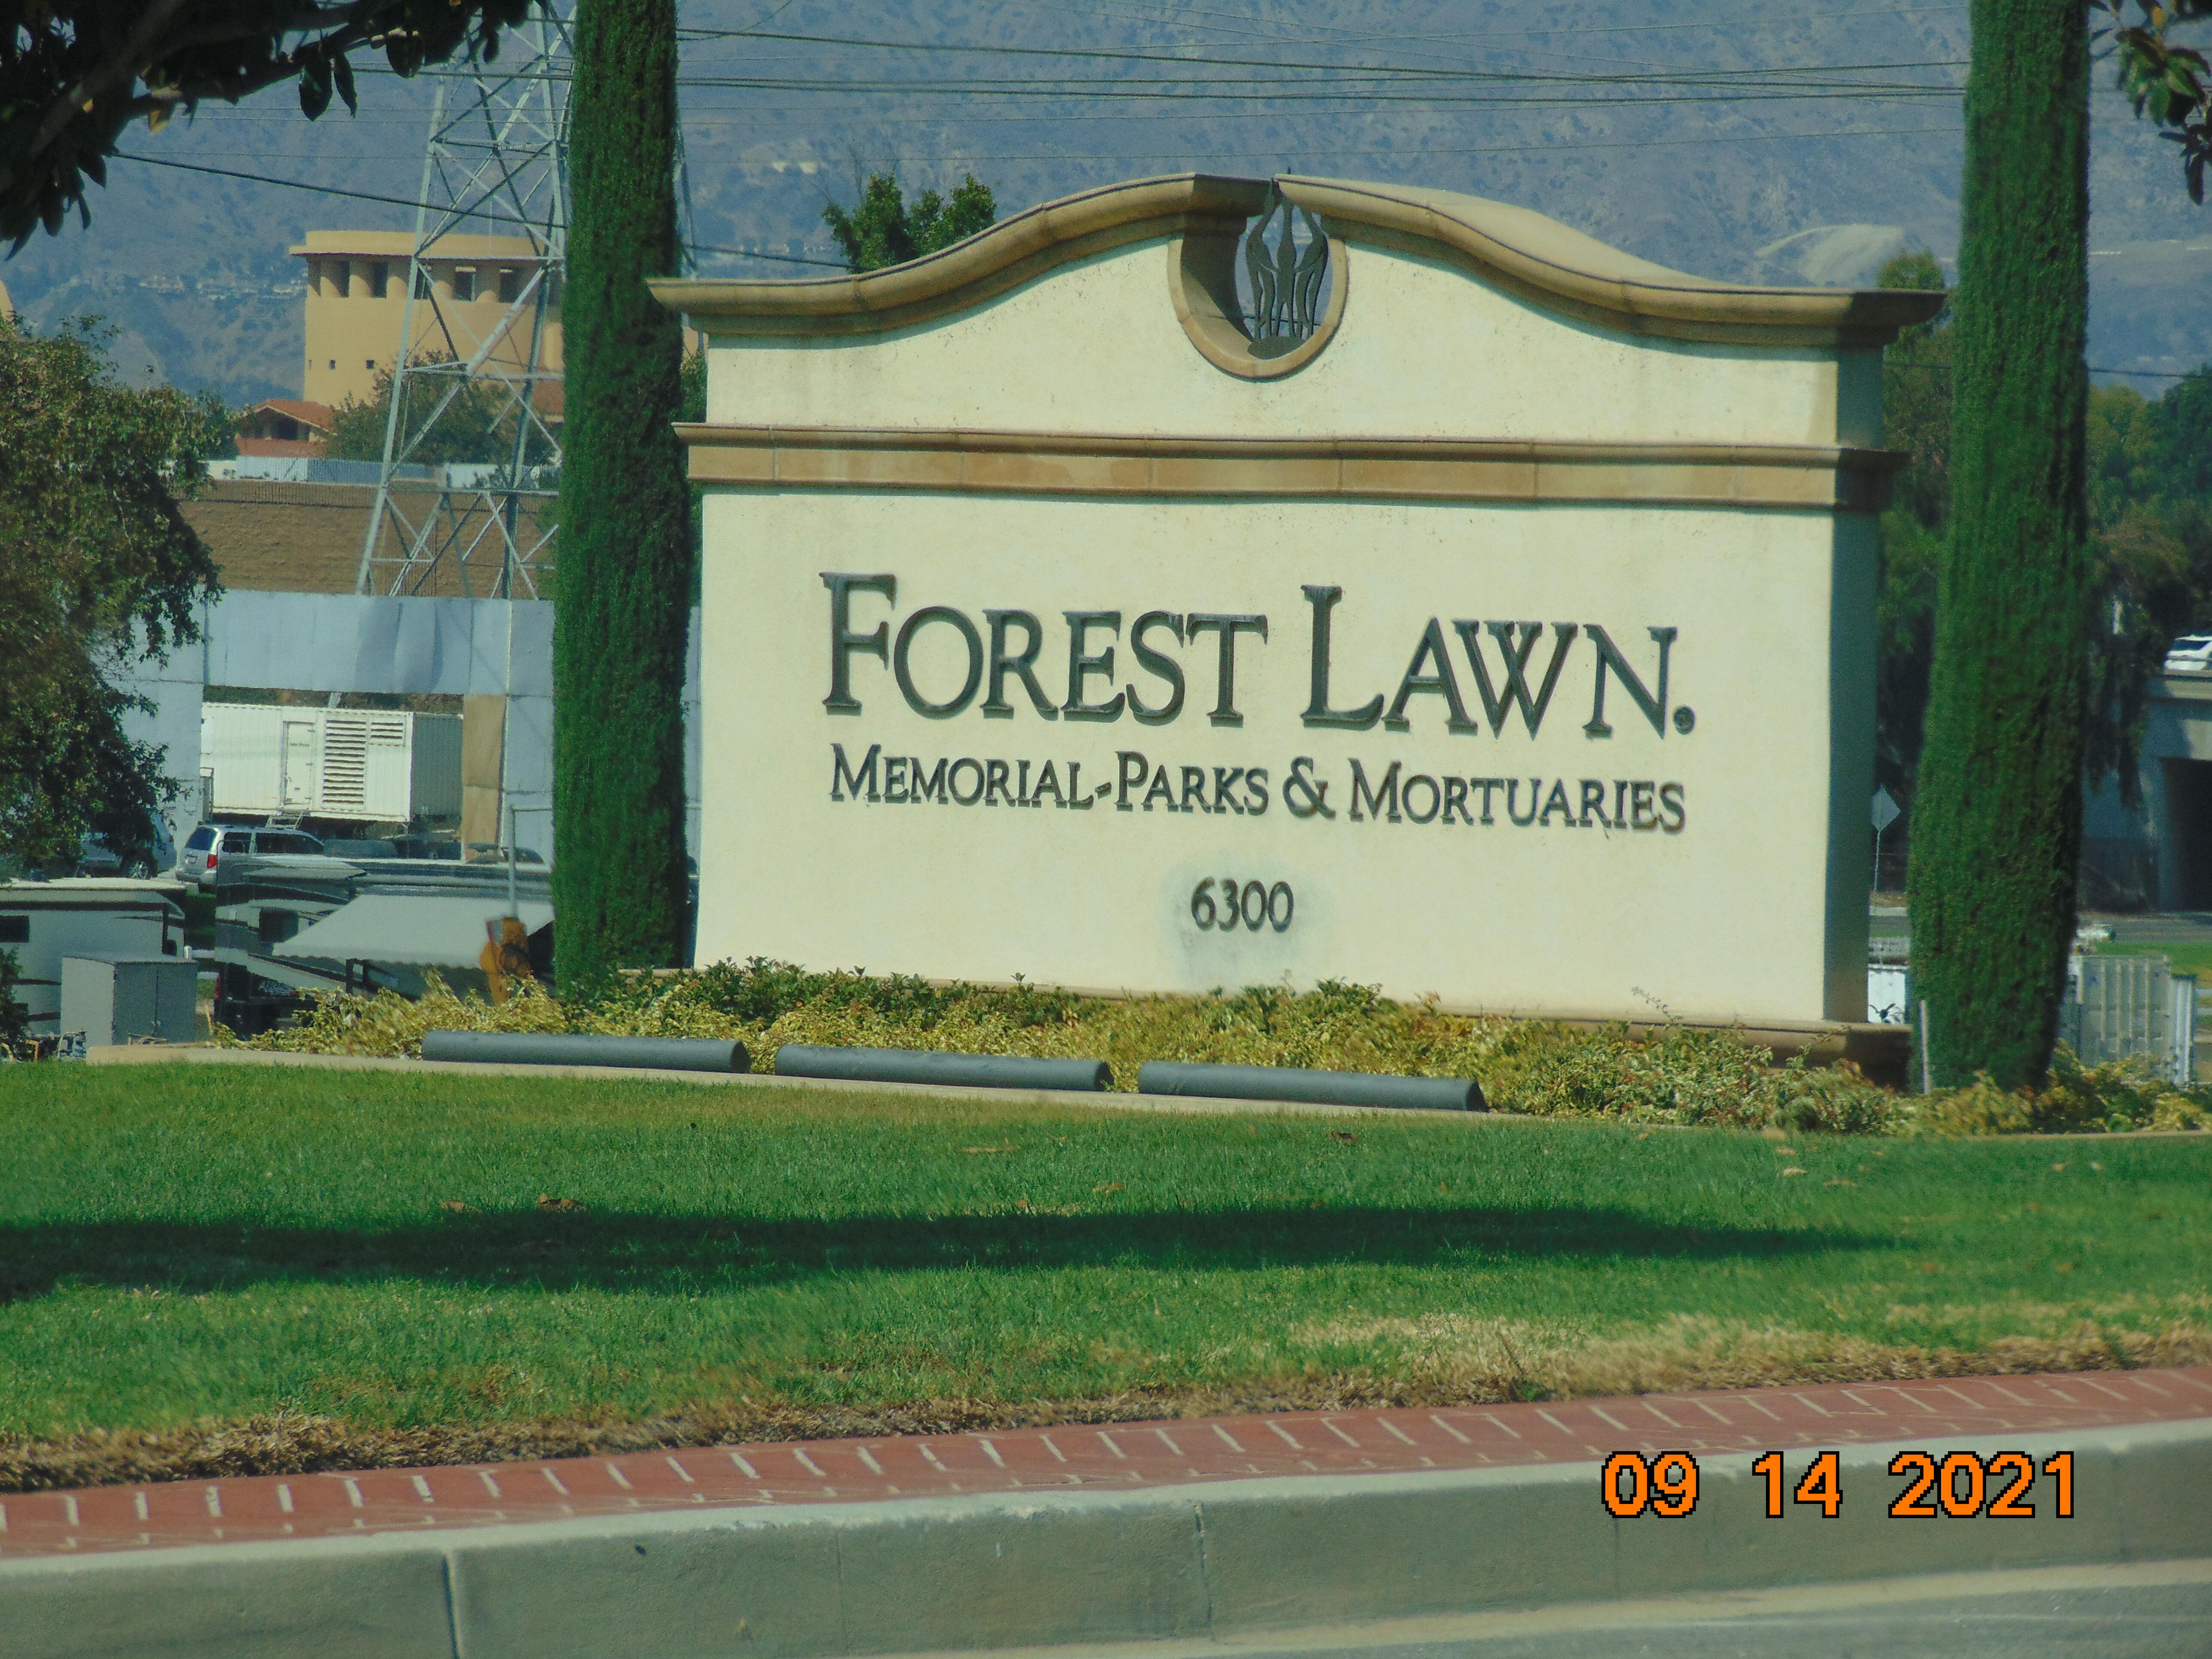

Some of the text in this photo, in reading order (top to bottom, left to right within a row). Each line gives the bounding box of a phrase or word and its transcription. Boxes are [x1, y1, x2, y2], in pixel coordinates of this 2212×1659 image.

[818, 572, 1269, 728] FOREST
[831, 743, 1685, 833] MEMORIAL-PARKS & MORTUARIES
[1191, 878, 1294, 933] 6300
